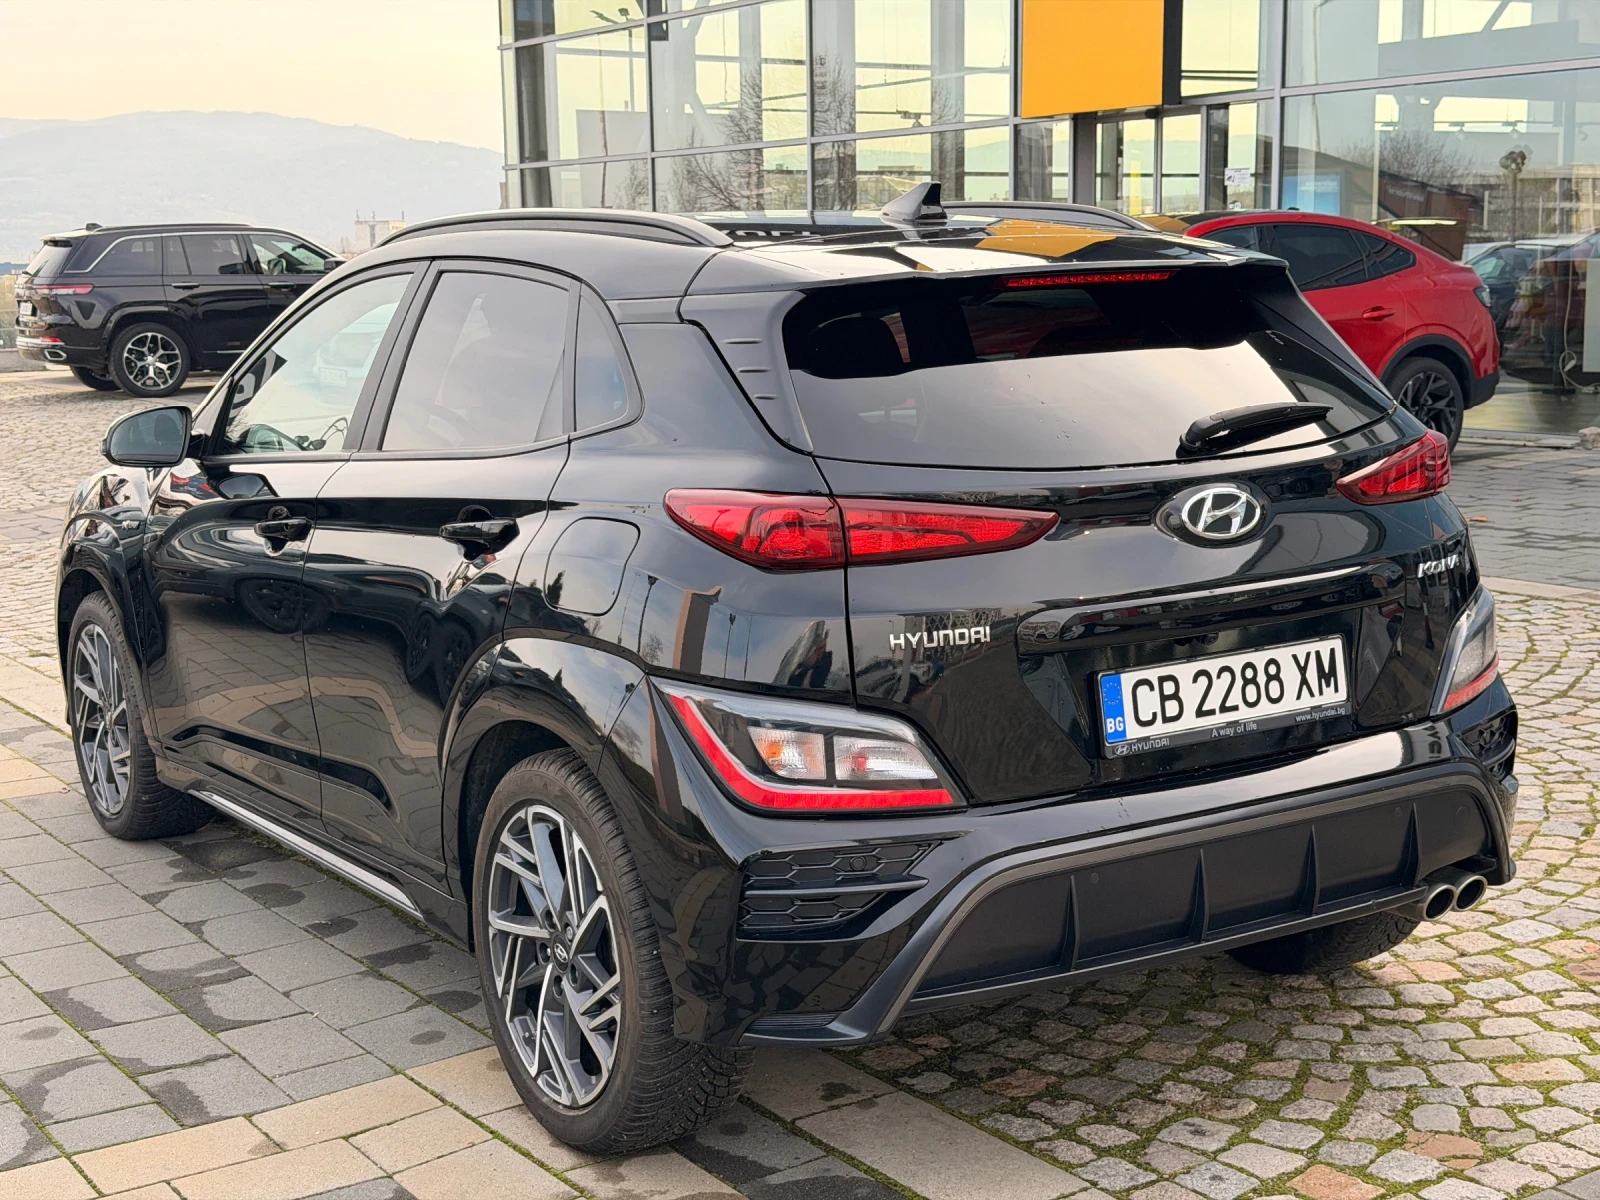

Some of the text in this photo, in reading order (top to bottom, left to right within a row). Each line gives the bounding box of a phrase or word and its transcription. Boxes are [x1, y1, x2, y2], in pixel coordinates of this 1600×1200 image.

[889, 625, 991, 651] HYUNDAI
[1131, 647, 1340, 727] CB 2288 XM
[1295, 706, 1346, 722] www.hyundai.bg
[1106, 716, 1124, 734] BG
[1211, 722, 1258, 738] A way of life
[1131, 737, 1170, 753] HYUNDAI
